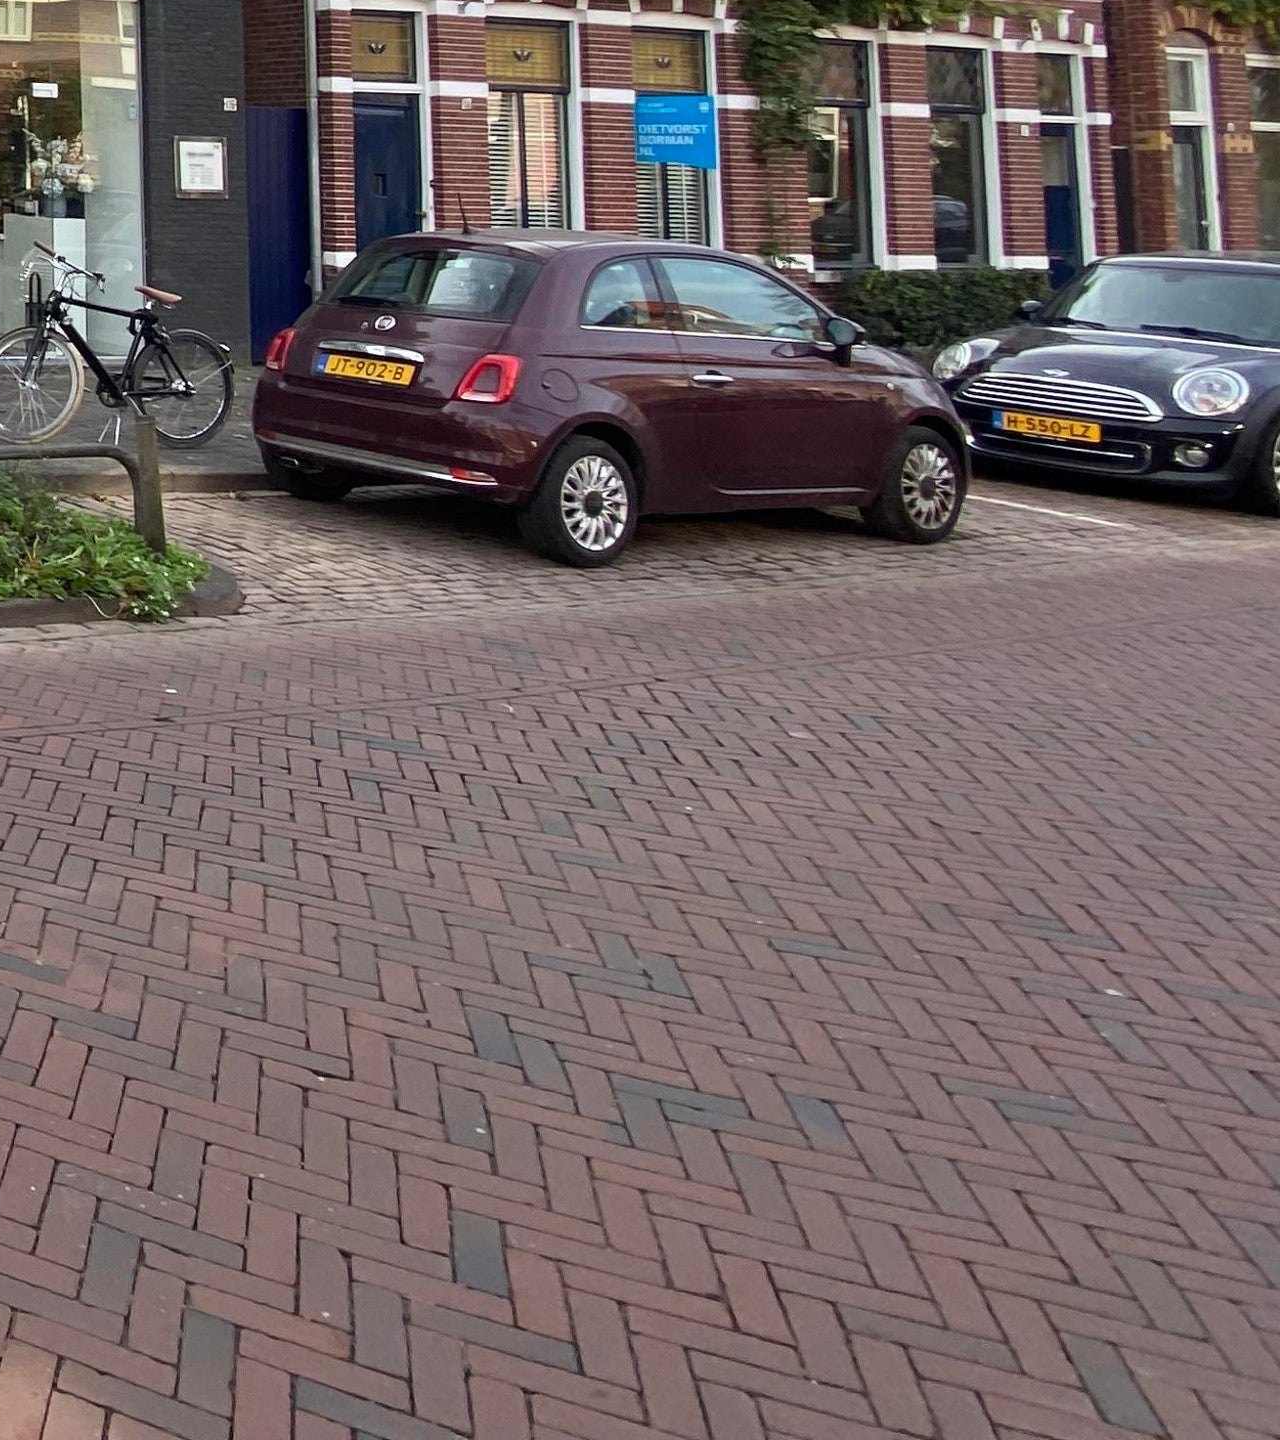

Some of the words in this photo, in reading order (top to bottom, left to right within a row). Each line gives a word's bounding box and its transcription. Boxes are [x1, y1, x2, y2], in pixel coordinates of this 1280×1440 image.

[638, 124, 708, 134] DIETVORST
[638, 135, 694, 145] BORMAN
[329, 357, 405, 381] JT-902-B
[1006, 414, 1091, 438] H-550-LZ
